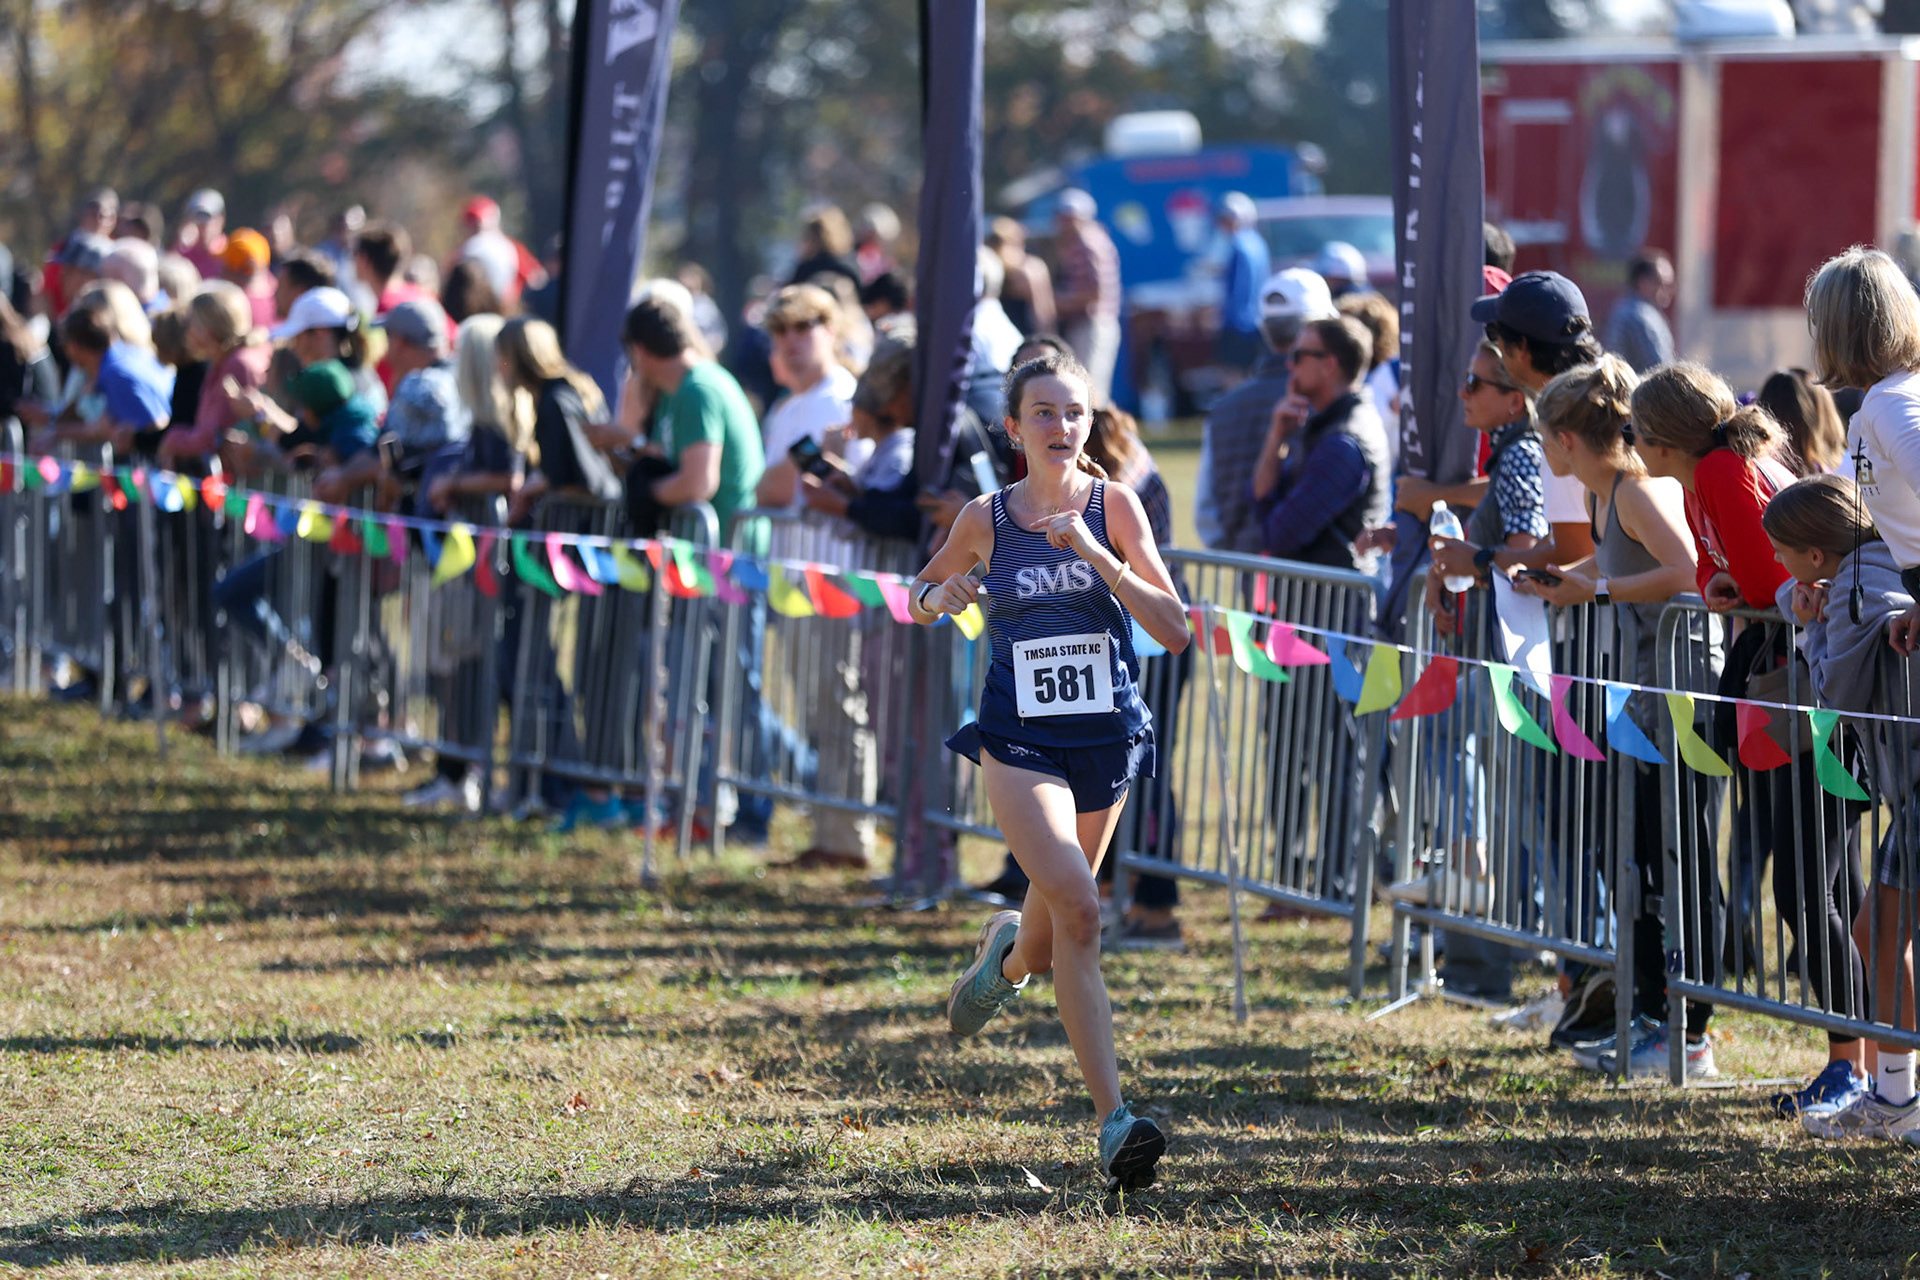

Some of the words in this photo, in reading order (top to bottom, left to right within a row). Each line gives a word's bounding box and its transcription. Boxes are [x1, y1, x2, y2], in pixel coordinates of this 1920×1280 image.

[1016, 561, 1093, 599] SMS
[1024, 647, 1058, 661] TMSAA
[1060, 644, 1087, 657] STATE
[1089, 643, 1101, 655] XC
[1033, 664, 1095, 704] 581
